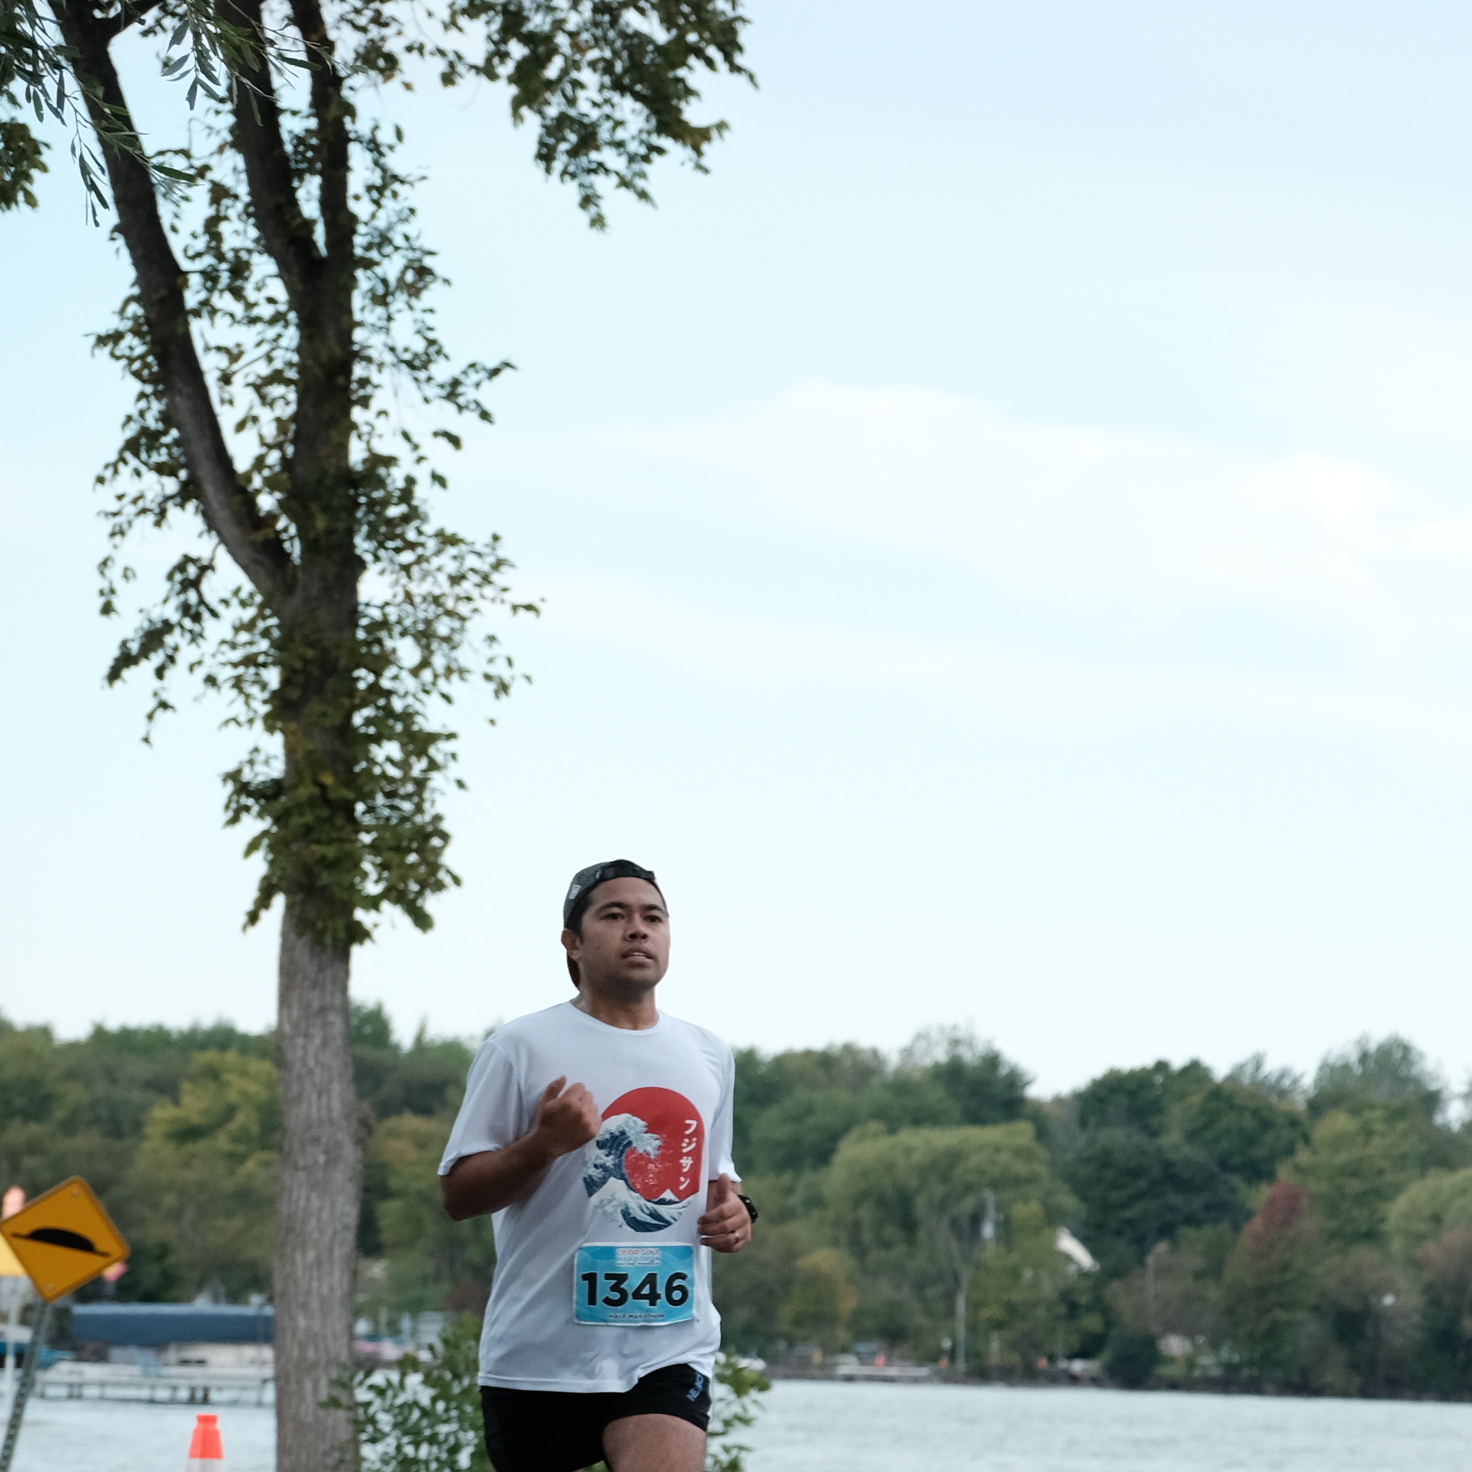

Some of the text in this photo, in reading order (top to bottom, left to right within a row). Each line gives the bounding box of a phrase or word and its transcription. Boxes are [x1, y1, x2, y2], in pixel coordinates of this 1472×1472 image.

[679, 1119, 698, 1190] フジサン
[581, 1271, 689, 1307] 1346
